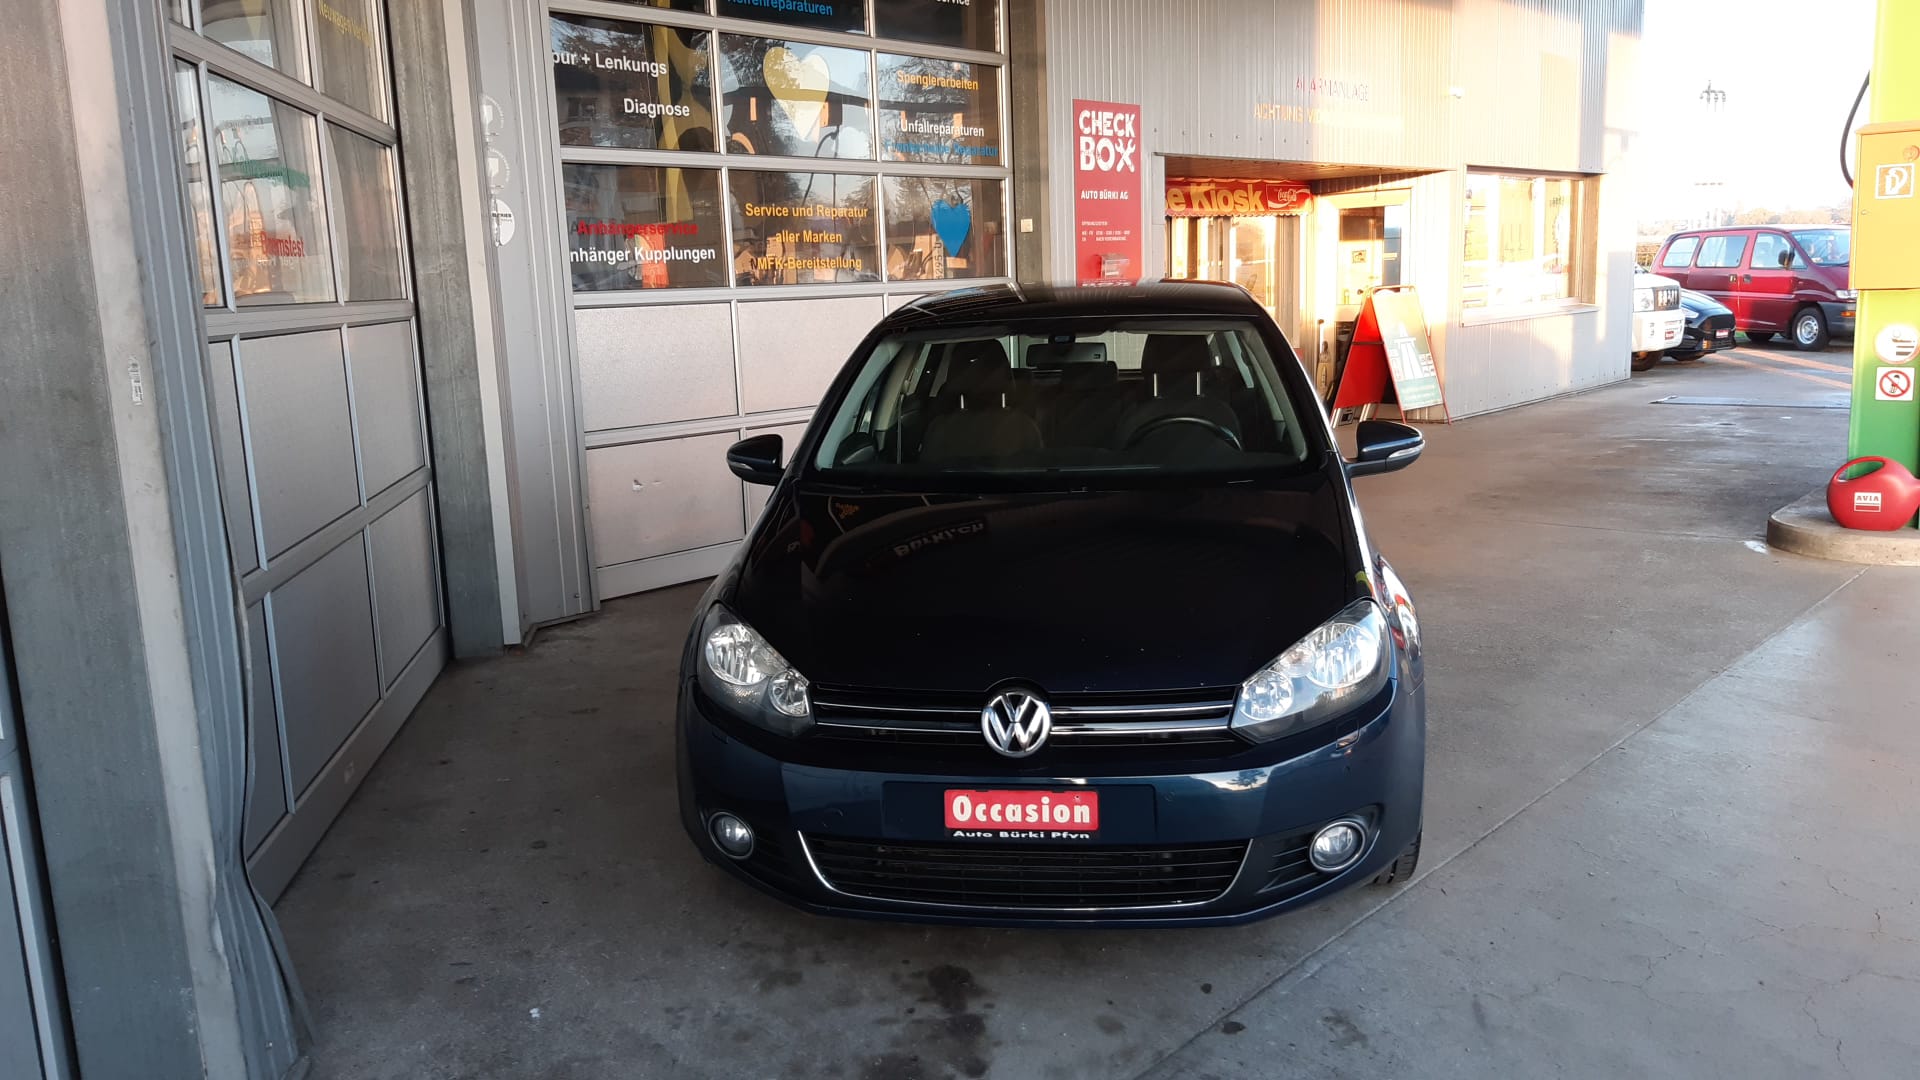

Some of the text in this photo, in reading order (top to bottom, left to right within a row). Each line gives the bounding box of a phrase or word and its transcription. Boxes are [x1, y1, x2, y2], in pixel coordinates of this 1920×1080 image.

[595, 52, 668, 78] Lenkungs
[896, 69, 979, 91] Spenglerarbeiten
[623, 97, 690, 119] Diagnose
[900, 118, 985, 137] Unfallreparaturen
[1079, 109, 1136, 138] CHECK
[1079, 135, 1136, 174] BOX
[1080, 189, 1099, 200] AUTO
[1119, 190, 1129, 200] AG
[1189, 182, 1266, 213] Kiosk
[744, 202, 868, 220] Service und Reparatur
[576, 218, 699, 240] Anhängerservice
[775, 229, 843, 243] aller Marken
[634, 245, 716, 264] Kupplungen
[757, 255, 863, 272] MFK-Bereitstellung
[952, 795, 1091, 824] Occasion
[952, 830, 993, 839] Auto
[999, 830, 1045, 839] Bürki
